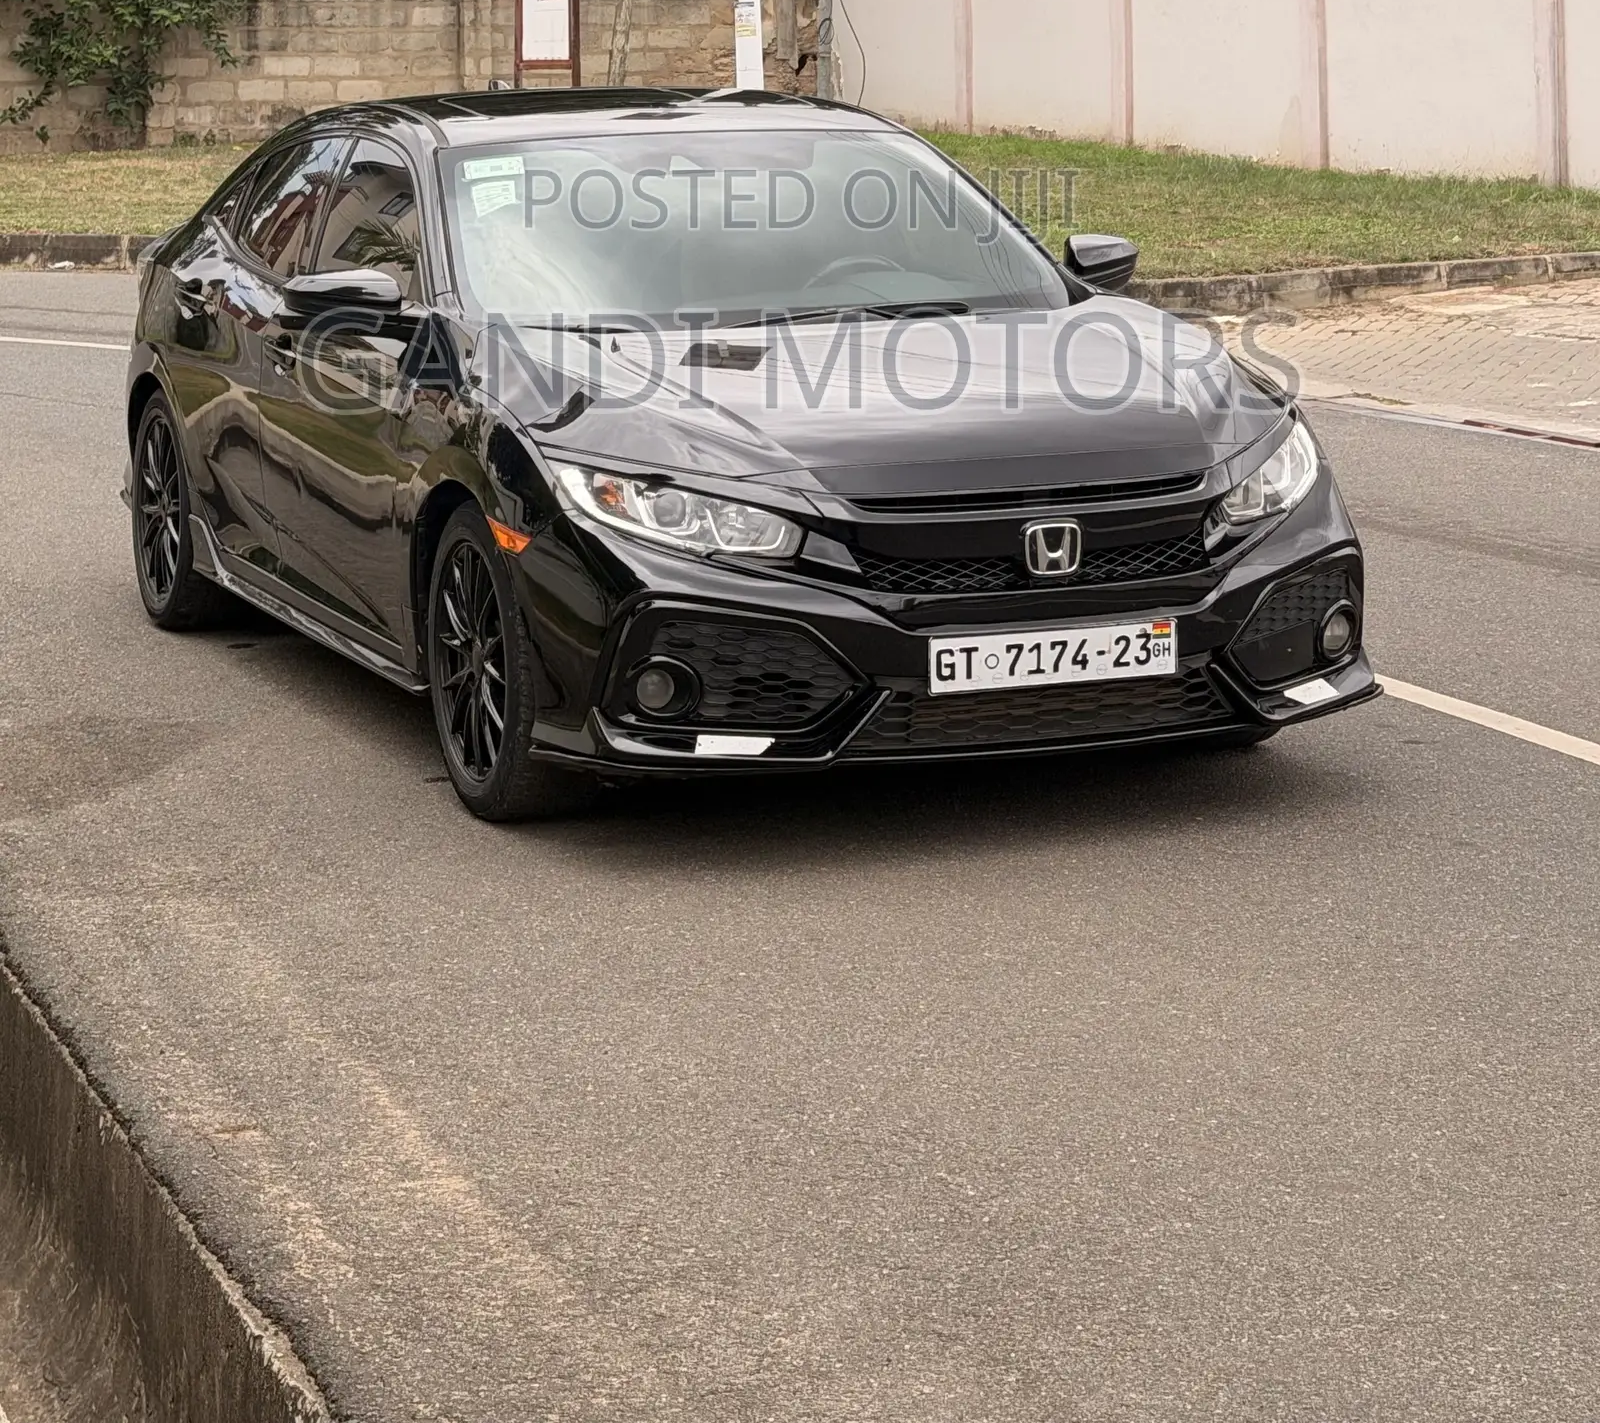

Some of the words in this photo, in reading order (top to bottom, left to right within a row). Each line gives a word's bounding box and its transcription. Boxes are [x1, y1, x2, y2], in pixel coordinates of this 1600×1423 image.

[935, 646, 980, 682] GT
[1004, 632, 1152, 677] 7174-23
[1152, 642, 1171, 658] GH
